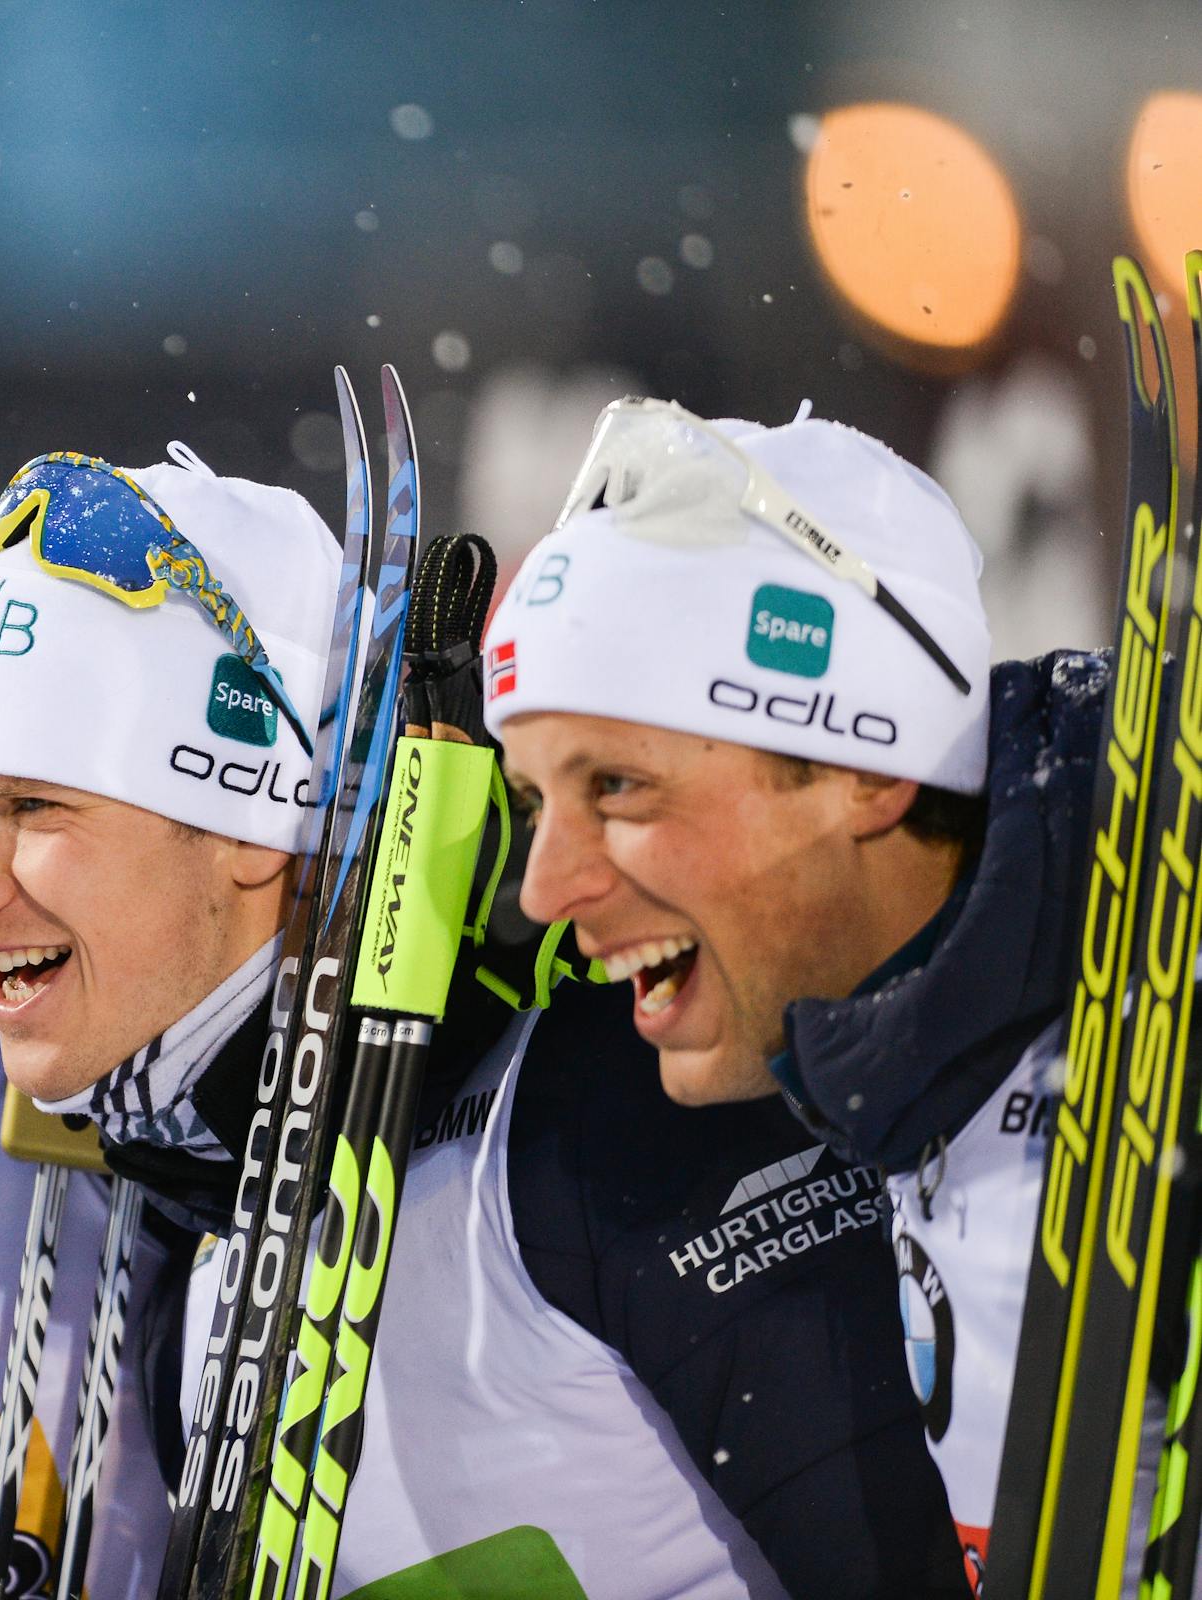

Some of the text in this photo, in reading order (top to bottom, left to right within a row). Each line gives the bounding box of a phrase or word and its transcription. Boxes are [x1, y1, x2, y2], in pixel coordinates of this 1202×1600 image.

[753, 609, 829, 649] Spare
[215, 681, 274, 717] Spare
[709, 678, 897, 745] odlo
[1041, 502, 1167, 1290] FISCHER
[1106, 520, 1202, 1292] FISCHE
[668, 1165, 883, 1277] HURTIGRUT
